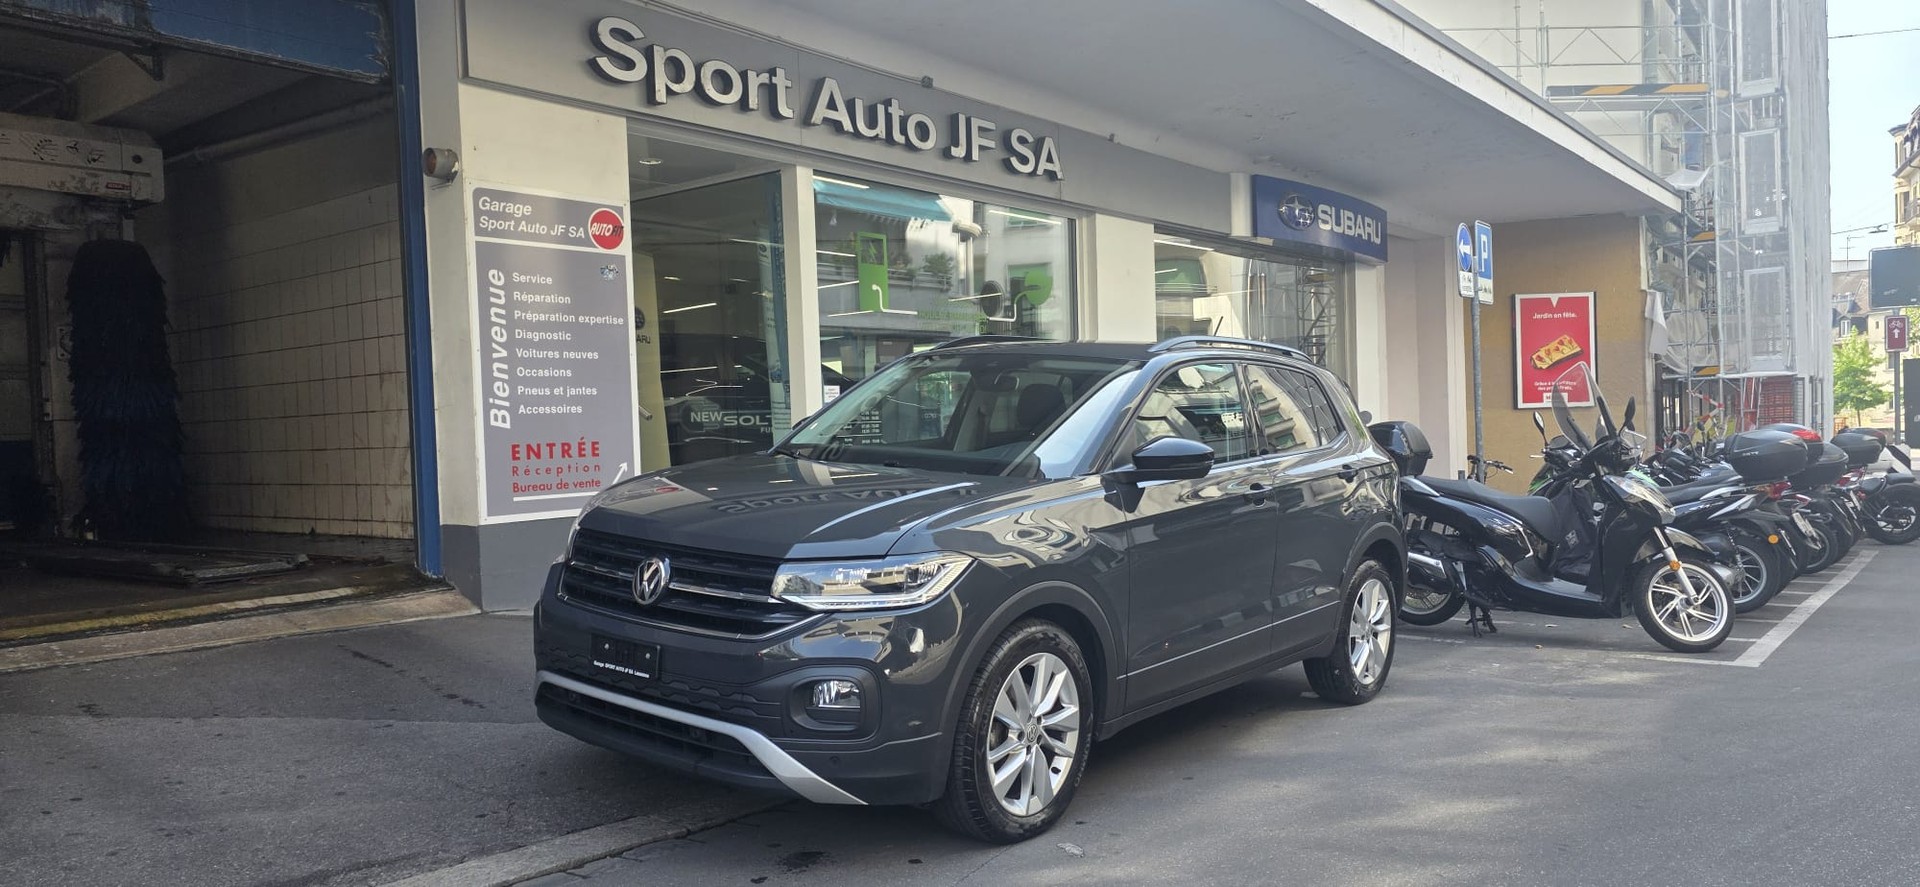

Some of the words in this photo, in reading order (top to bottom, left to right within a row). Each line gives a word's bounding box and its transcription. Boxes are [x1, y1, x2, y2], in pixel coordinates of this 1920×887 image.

[591, 16, 794, 119] Sport
[807, 76, 937, 151] Auto
[949, 112, 997, 163] JF
[1007, 128, 1064, 181] SA
[478, 196, 532, 217] Garage
[479, 216, 515, 232] Sport
[518, 221, 547, 234] Auto
[550, 226, 565, 237] JF
[568, 227, 585, 238] SA
[1317, 204, 1381, 245] SUBARU
[512, 272, 552, 284] Service
[513, 291, 571, 304] Réparation
[514, 310, 575, 323] Préparation
[578, 315, 624, 326] expertise
[515, 329, 572, 341] Diagnostic
[636, 334, 651, 344] ARU
[488, 269, 511, 429] Bienvenue
[516, 348, 559, 359] Voitures
[563, 350, 599, 360] neuves
[516, 366, 572, 377] Occasions
[517, 386, 550, 396] Pneus
[553, 386, 564, 396] et
[566, 386, 597, 397] jantes
[518, 404, 582, 414] Accessoires
[690, 411, 723, 422] NEW
[511, 437, 600, 461] ENTRÉE
[511, 463, 600, 477] Réception
[512, 482, 552, 493] Bureau
[556, 479, 569, 490] de
[572, 478, 601, 488] vente
